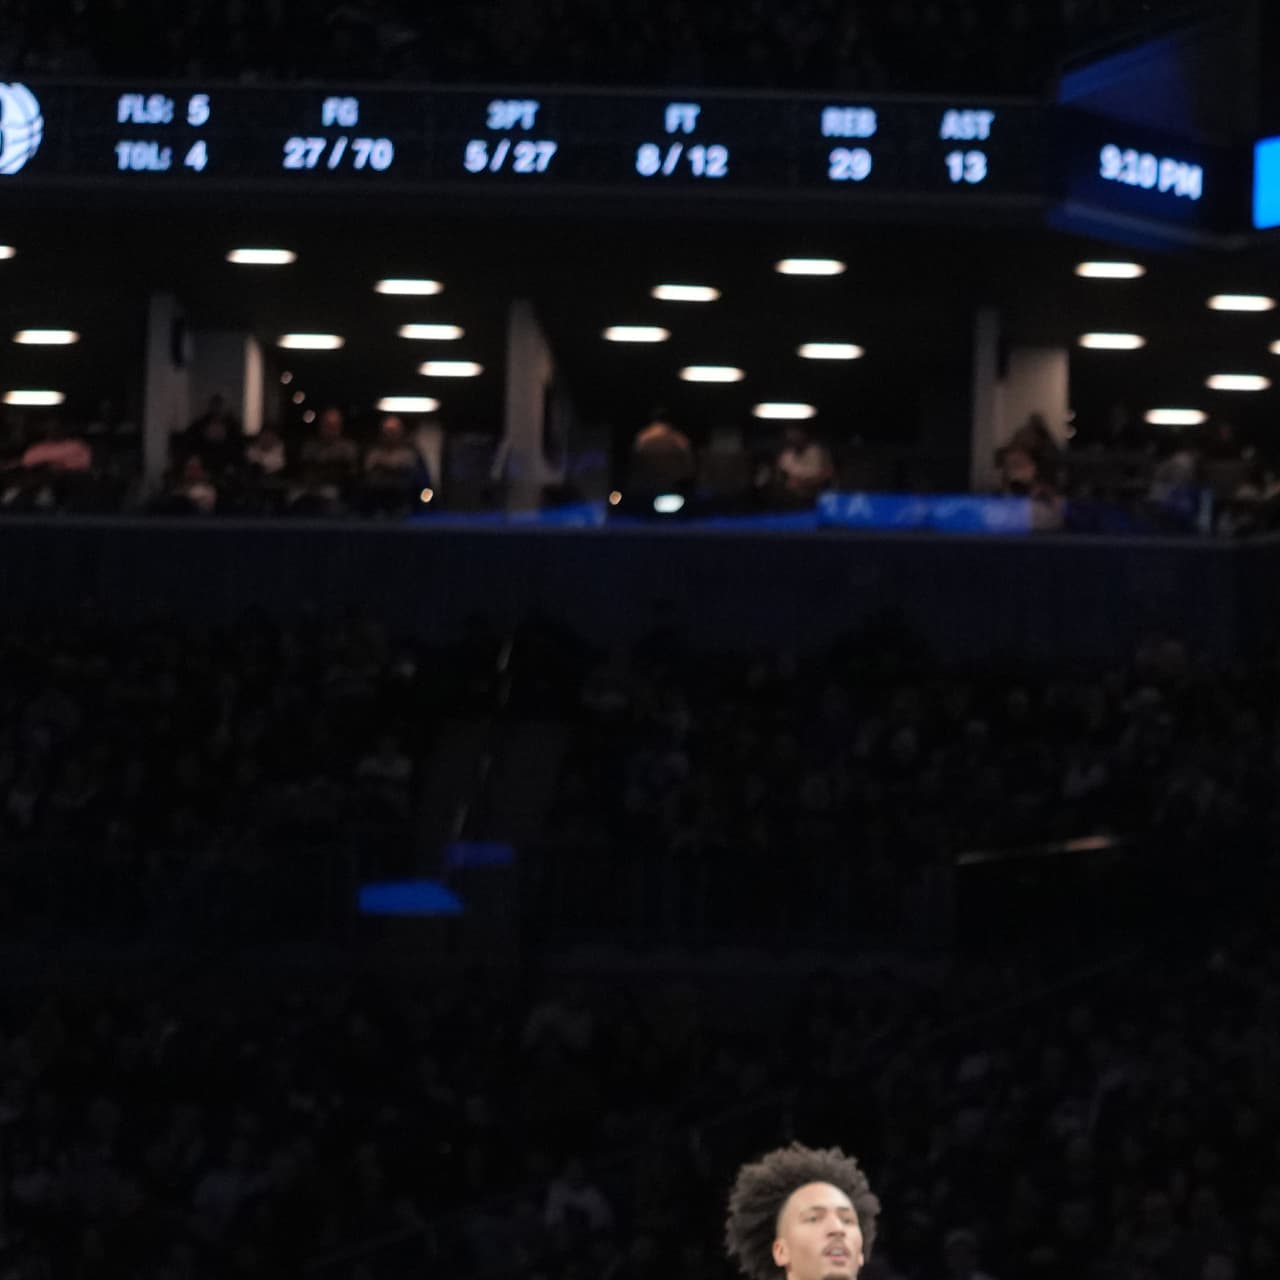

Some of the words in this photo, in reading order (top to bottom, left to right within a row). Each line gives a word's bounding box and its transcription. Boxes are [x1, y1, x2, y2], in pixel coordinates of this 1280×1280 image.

[187, 94, 210, 127] 5
[321, 96, 359, 127] FG
[665, 102, 700, 134] FT
[821, 106, 877, 137] REB
[940, 108, 995, 140] AST
[184, 141, 208, 171] 4
[946, 150, 988, 183] 13
[1158, 157, 1203, 200] PM
